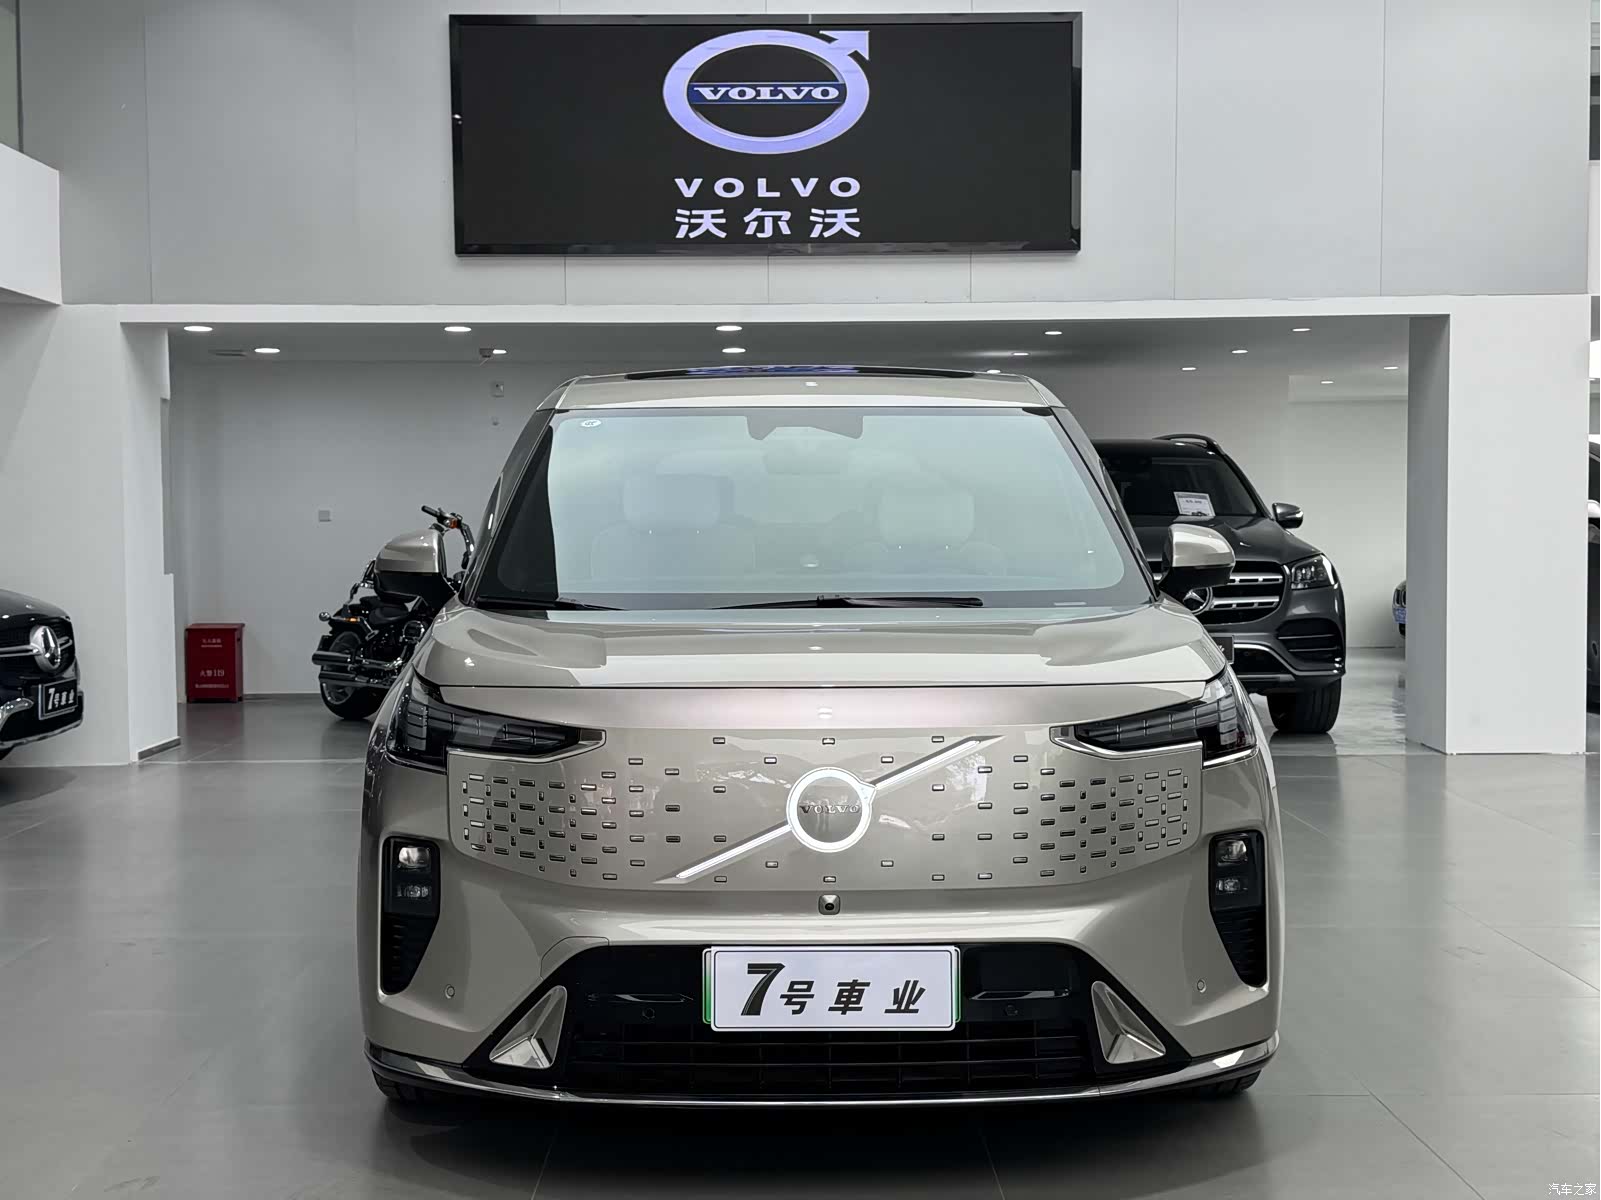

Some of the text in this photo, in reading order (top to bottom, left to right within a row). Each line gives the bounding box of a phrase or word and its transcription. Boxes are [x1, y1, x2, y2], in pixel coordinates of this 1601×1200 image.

[693, 86, 840, 100] VOLVO
[674, 176, 861, 198] VOLVO
[675, 207, 861, 239] 沃尔沃
[799, 804, 861, 814] VOLVO
[740, 962, 926, 1016] 7号車业
